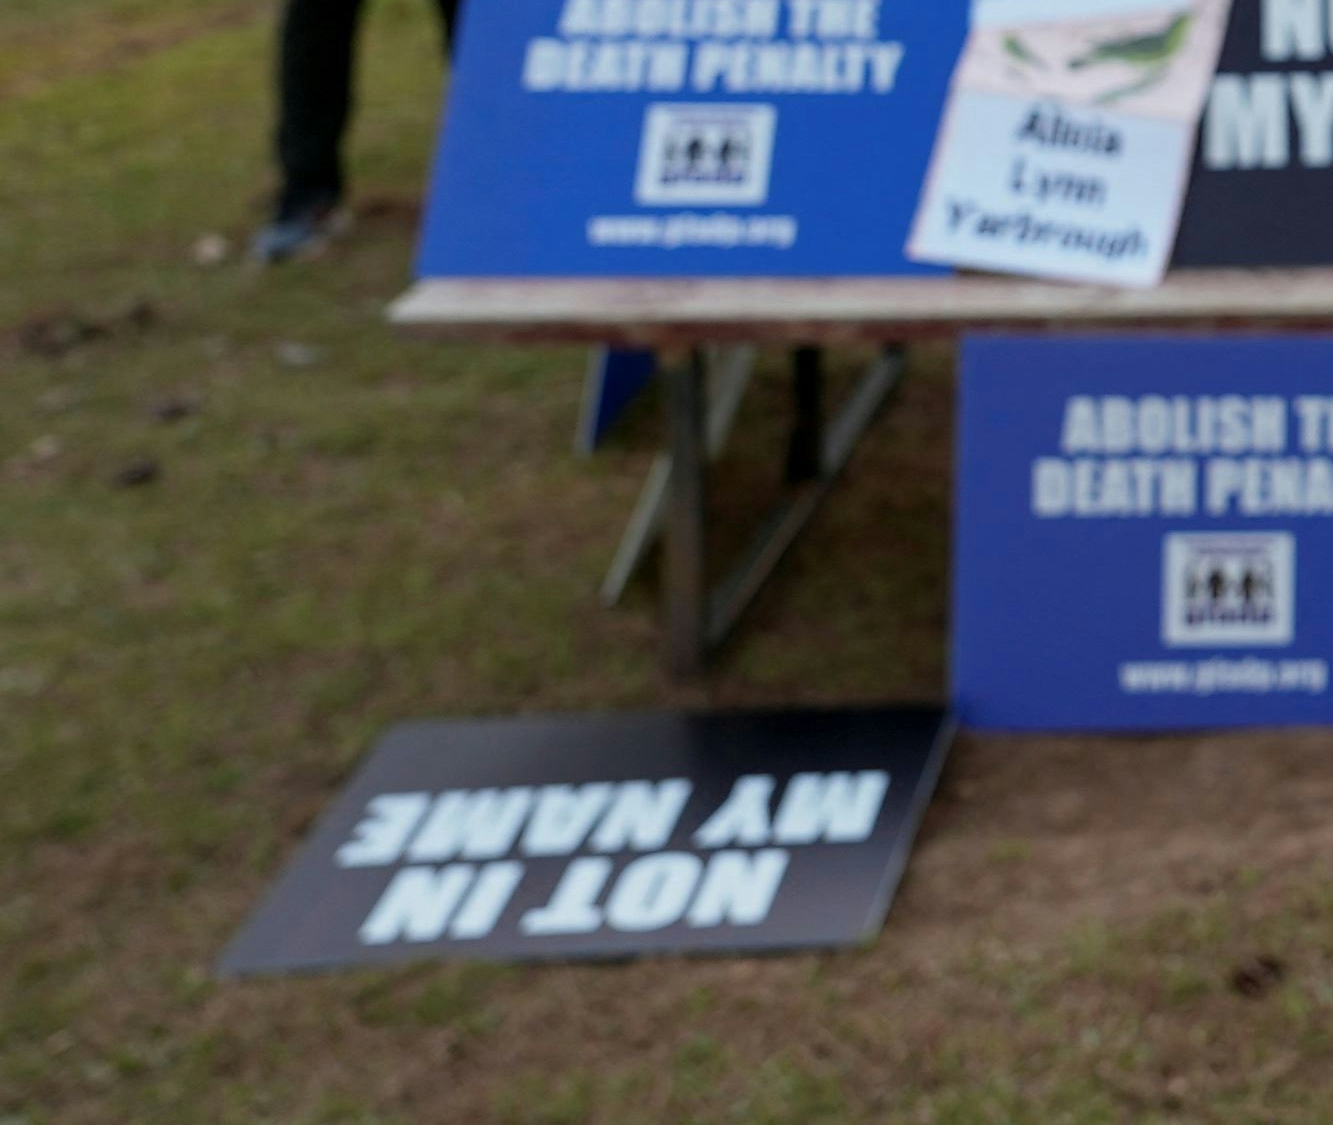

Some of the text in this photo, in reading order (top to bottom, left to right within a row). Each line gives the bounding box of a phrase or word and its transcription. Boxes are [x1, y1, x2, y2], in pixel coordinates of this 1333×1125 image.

[525, 39, 903, 92] DEATH PENALTY
[1013, 163, 1105, 204] Lynn
[1062, 396, 1285, 453] ABOLISH
[1033, 457, 1195, 516] DEATH
[336, 771, 888, 867] MY NAME
[359, 851, 788, 944] NOT IN
